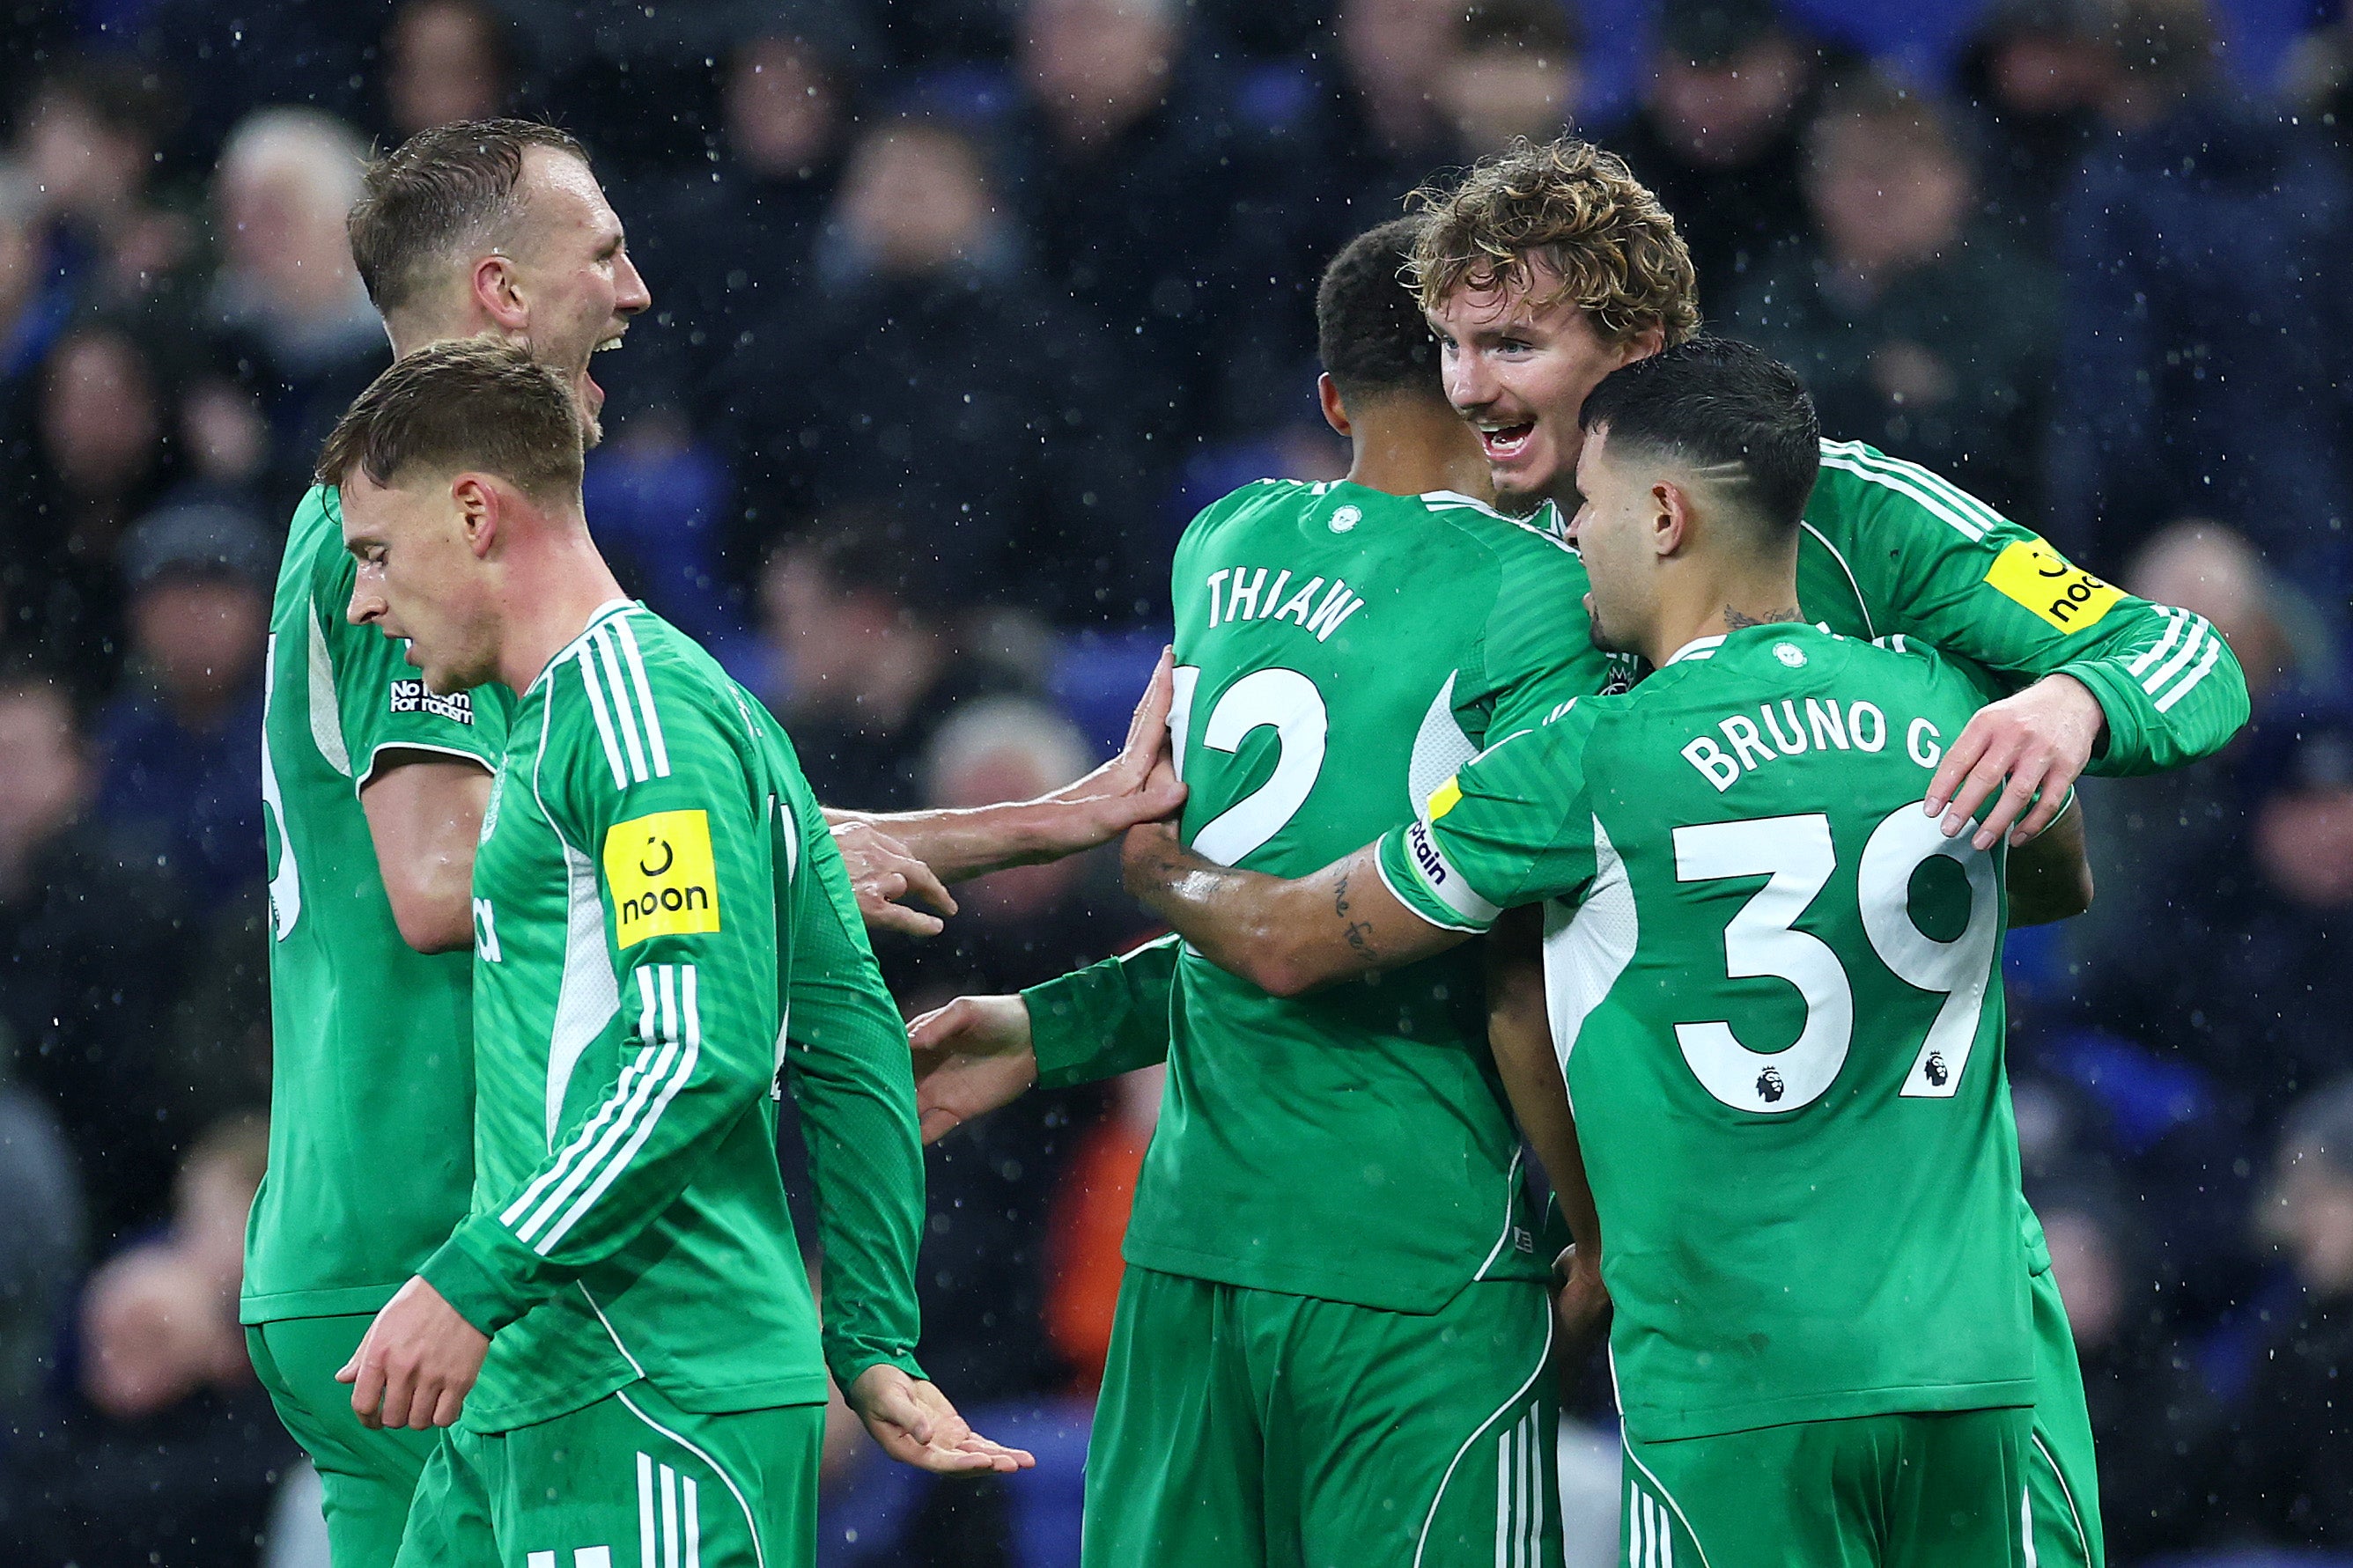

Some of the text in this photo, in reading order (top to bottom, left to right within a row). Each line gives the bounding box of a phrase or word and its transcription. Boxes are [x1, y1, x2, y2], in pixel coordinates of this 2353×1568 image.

[1206, 565, 1365, 644] THIAW
[2048, 575, 2105, 623] noo
[390, 680, 421, 697] No
[421, 697, 474, 725] racism
[1680, 696, 1887, 793] BRUNO
[622, 885, 709, 924] noon
[1671, 799, 1999, 1115] 39
